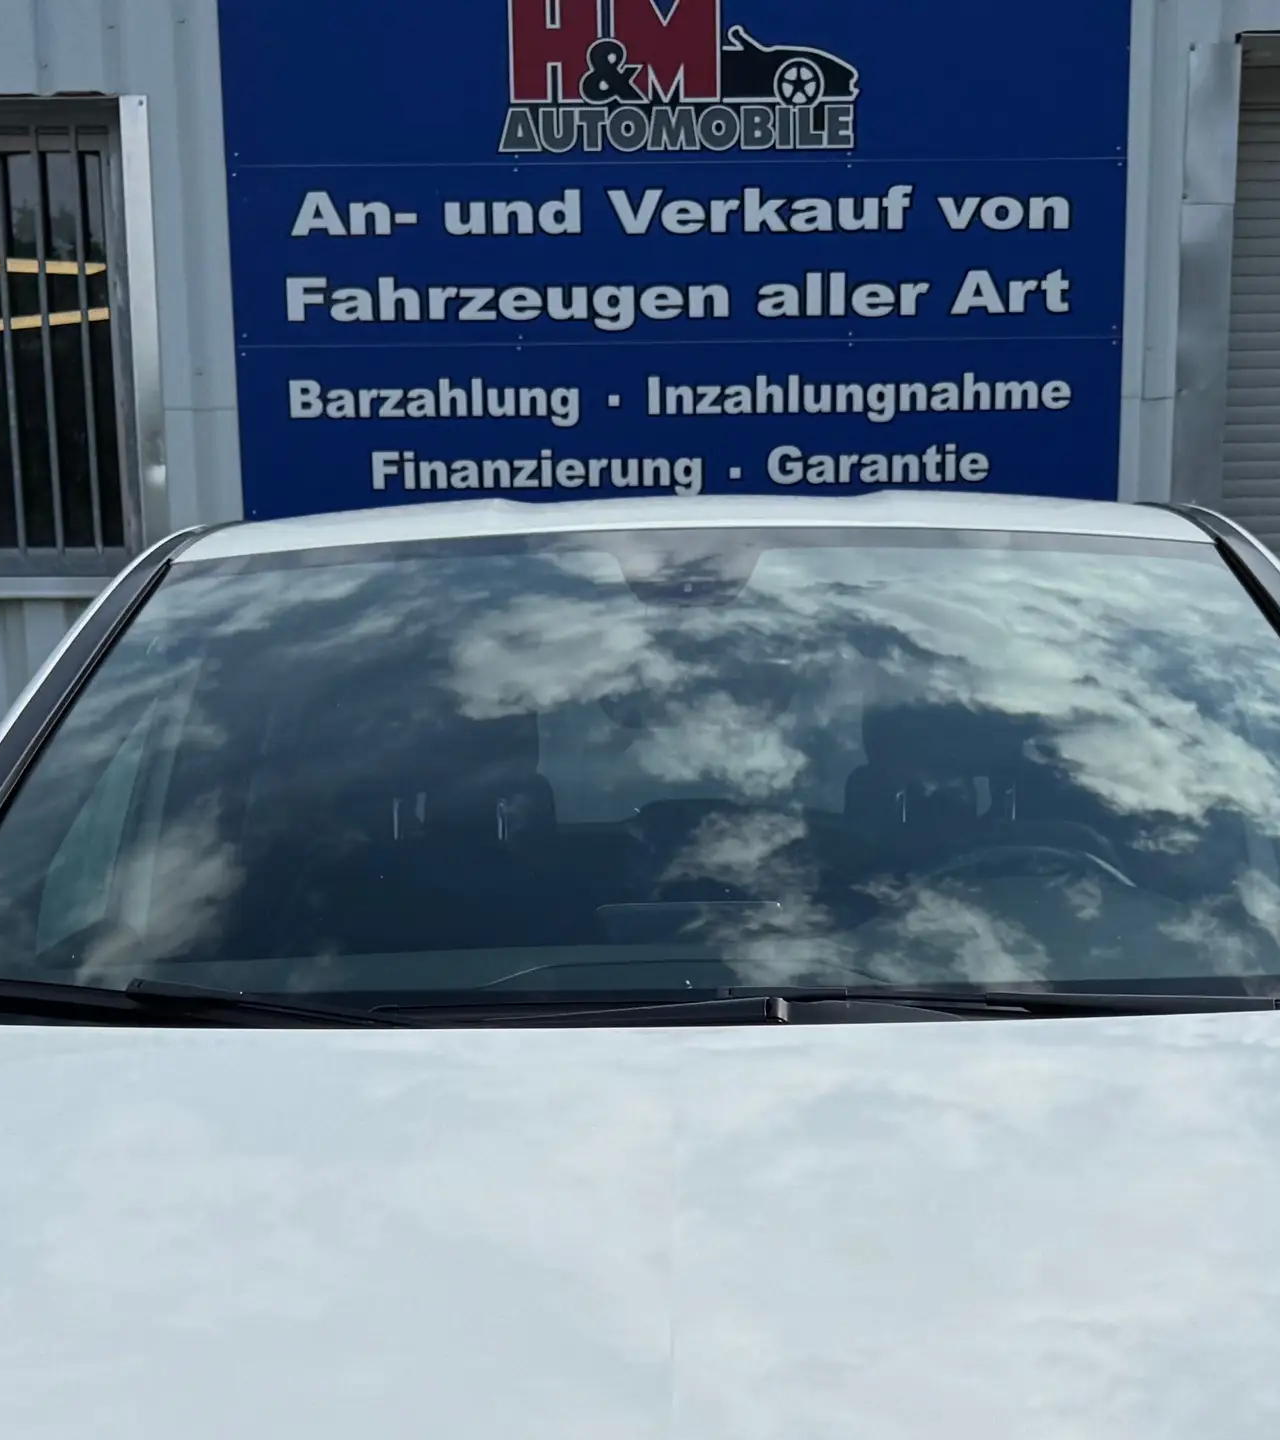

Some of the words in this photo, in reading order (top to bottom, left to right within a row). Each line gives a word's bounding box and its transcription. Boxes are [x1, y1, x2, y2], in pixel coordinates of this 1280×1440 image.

[507, 0, 722, 104] H&M
[498, 104, 855, 153] AUTOMOBILE
[290, 190, 418, 238] An-
[443, 189, 583, 236] und
[606, 184, 912, 237] Verkauf
[937, 194, 1072, 232] von
[284, 275, 732, 331] Fahrzeugen
[756, 271, 929, 319] aller
[949, 268, 1071, 316] Art
[286, 377, 581, 428] Barzahlung
[645, 372, 1073, 424] Inzahlungnahme
[369, 449, 704, 496] Finanzierung
[765, 442, 991, 485] Garantie
